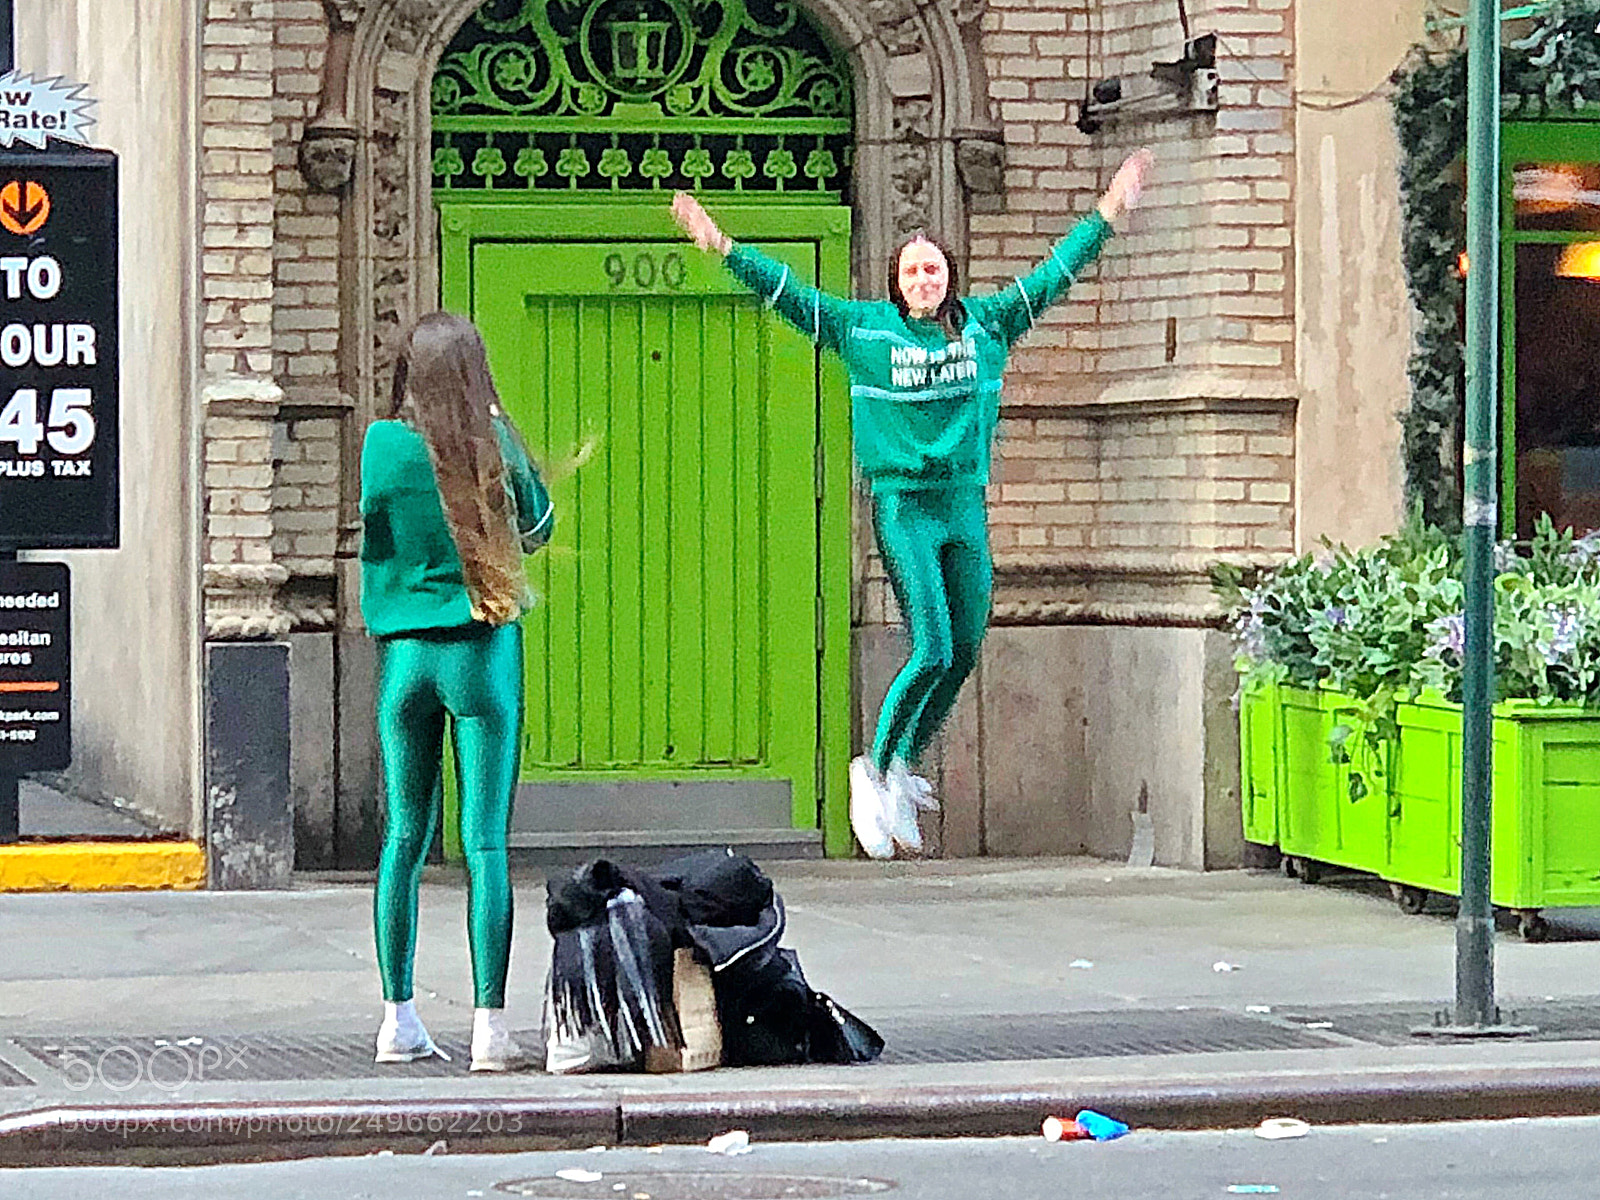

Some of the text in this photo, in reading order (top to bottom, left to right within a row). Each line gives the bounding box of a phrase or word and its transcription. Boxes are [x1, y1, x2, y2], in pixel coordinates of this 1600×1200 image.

[0, 91, 32, 106] w
[0, 110, 67, 130] Rate!
[0, 256, 62, 300] TO
[604, 252, 687, 290] 900
[0, 323, 97, 367] OUR
[0, 388, 95, 455] 45
[51, 460, 92, 477] TAX
